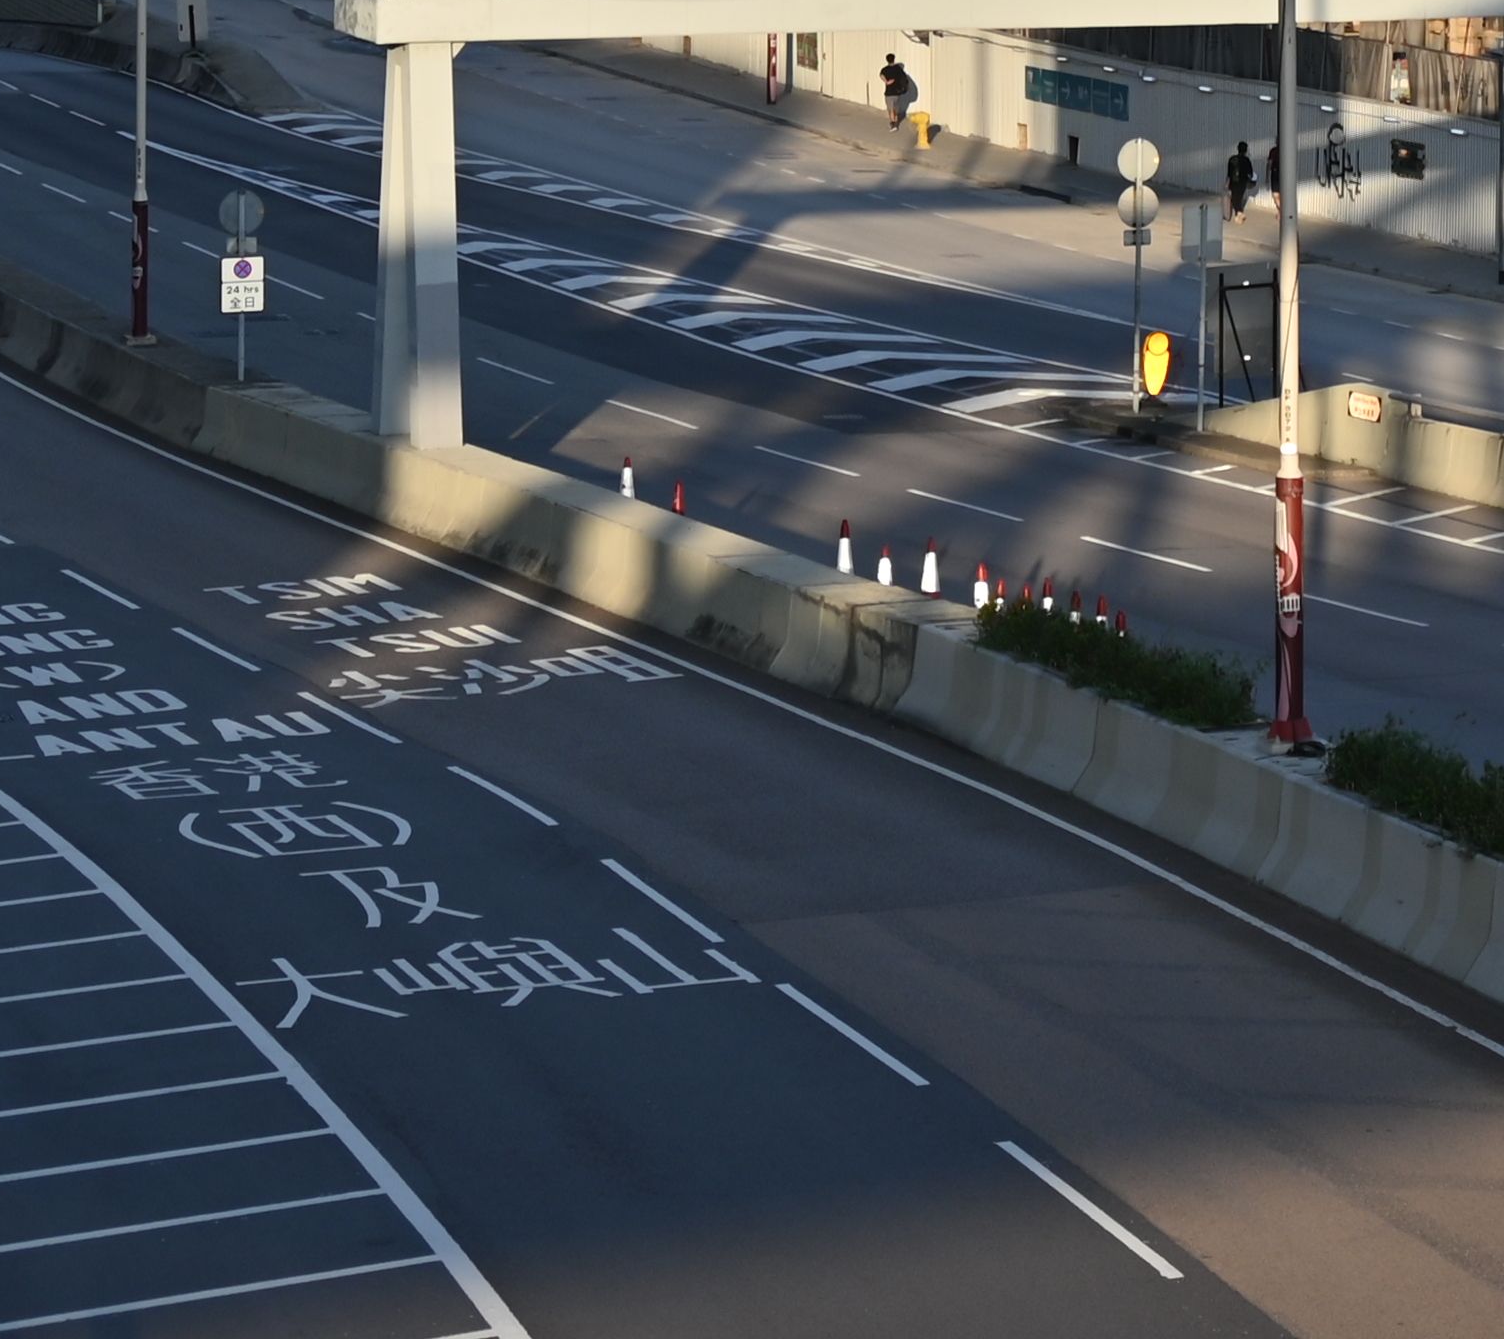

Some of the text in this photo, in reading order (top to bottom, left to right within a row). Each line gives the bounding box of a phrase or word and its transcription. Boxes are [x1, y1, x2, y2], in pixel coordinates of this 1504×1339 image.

[226, 285, 259, 294] 24 hrs
[230, 296, 256, 310] 全日
[203, 573, 402, 605] TSIM
[265, 601, 443, 630] SHA
[314, 624, 522, 658] TSUI
[328, 645, 684, 709] 尖沙咀
[16, 689, 186, 725] AND
[90, 750, 349, 801] 香港
[178, 801, 412, 858] (西)
[300, 866, 483, 928] 及
[236, 927, 762, 1029] 大嶼山
